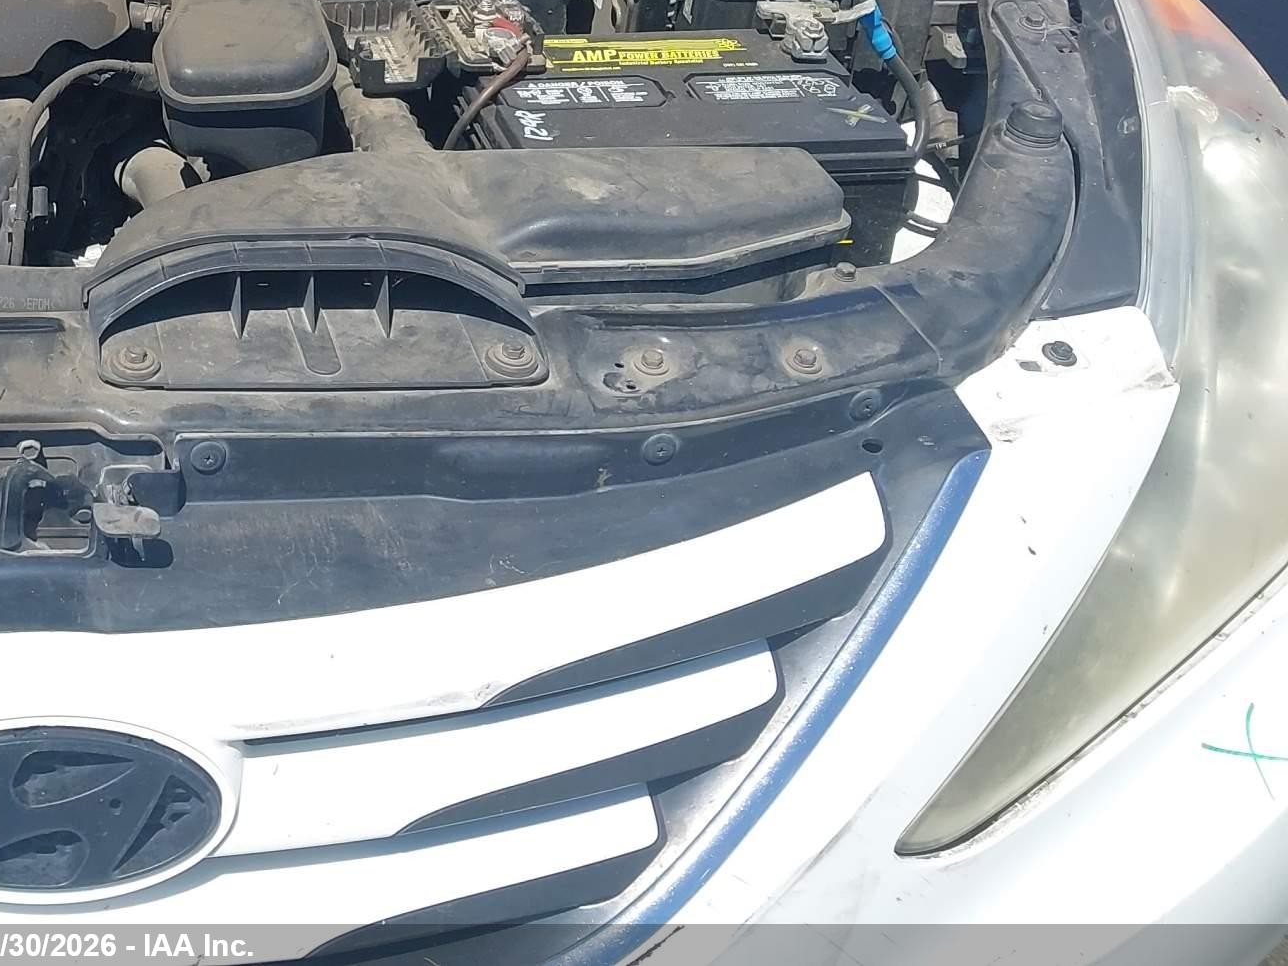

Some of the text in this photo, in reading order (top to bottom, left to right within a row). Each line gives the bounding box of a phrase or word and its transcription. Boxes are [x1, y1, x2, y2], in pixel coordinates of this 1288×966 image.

[572, 49, 720, 62] AMP POWER BATTERIES
[586, 79, 625, 88] POISON
